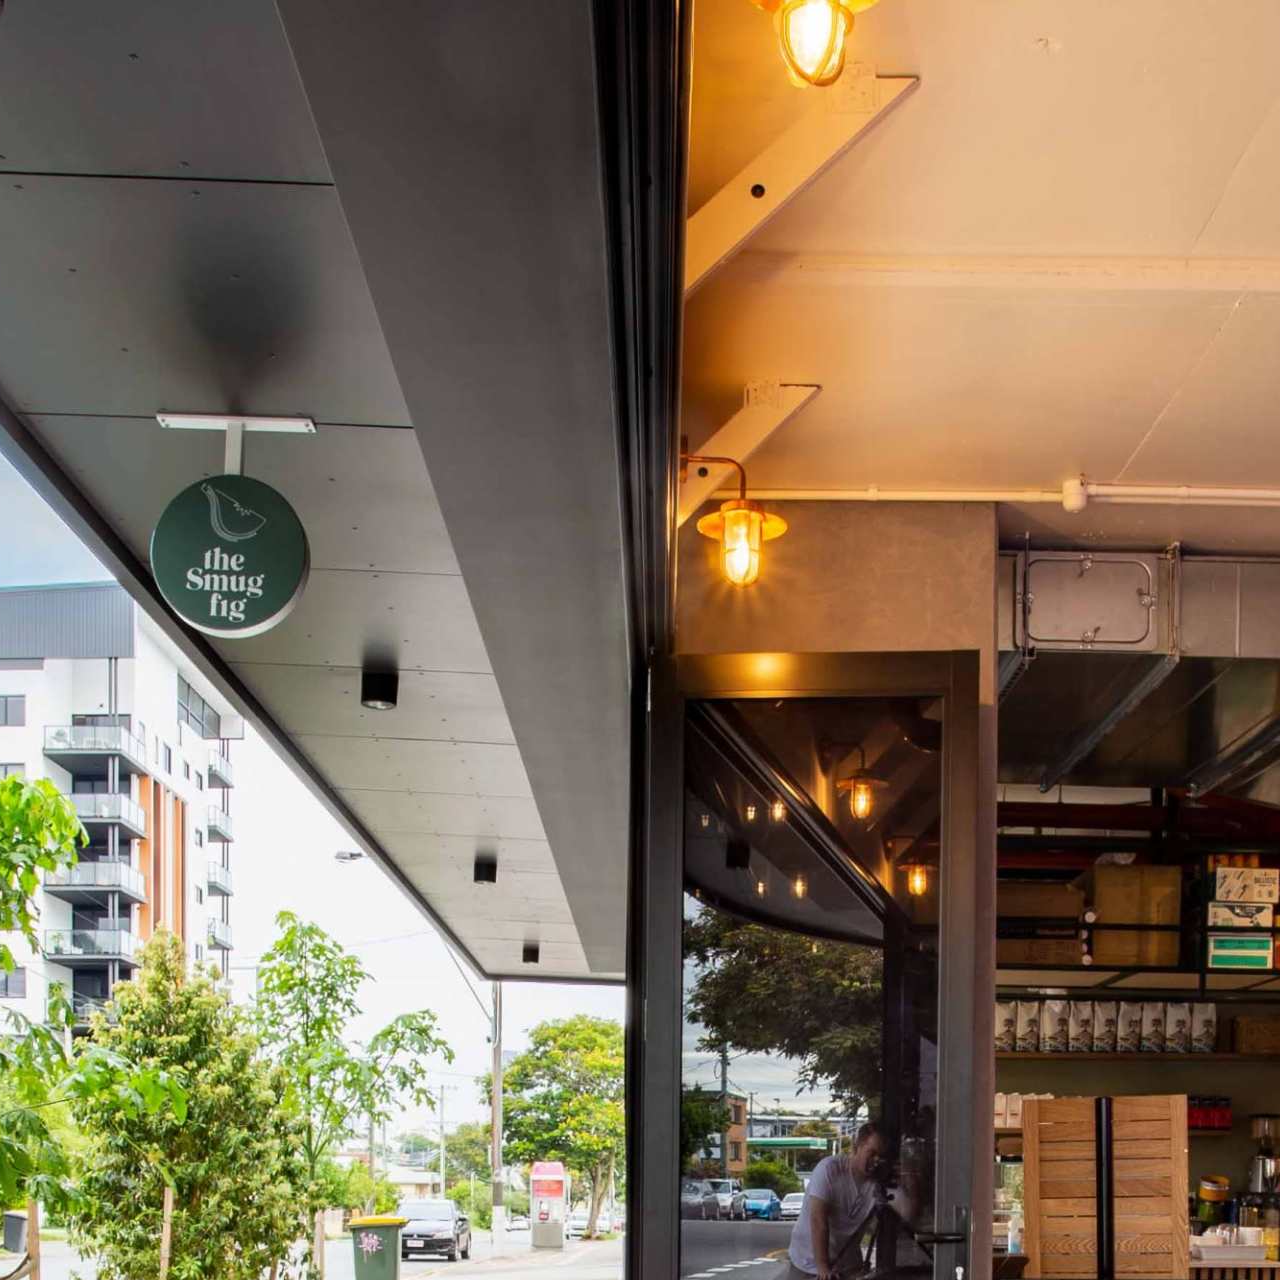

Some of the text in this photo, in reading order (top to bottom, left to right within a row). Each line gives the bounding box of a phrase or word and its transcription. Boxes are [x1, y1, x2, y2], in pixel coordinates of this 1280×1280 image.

[204, 547, 245, 571] the
[186, 567, 264, 598] Smug
[210, 592, 247, 623] fig
